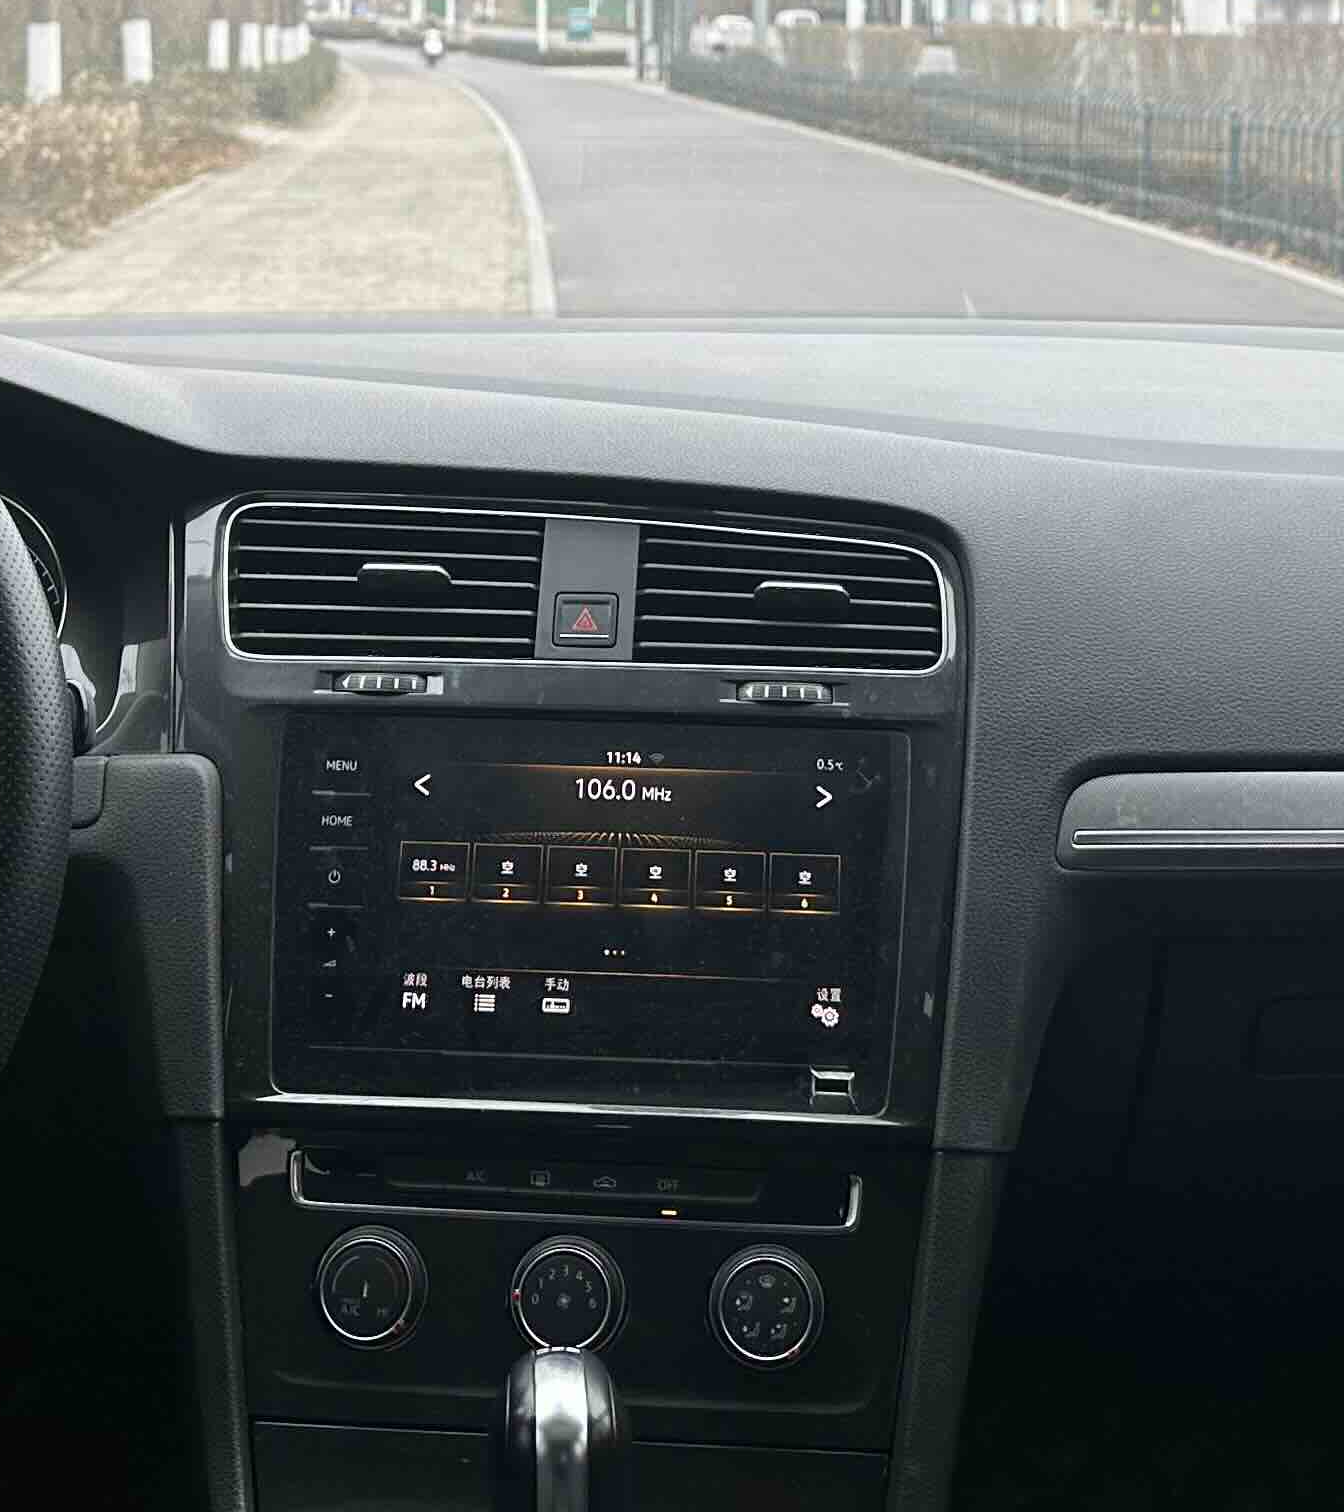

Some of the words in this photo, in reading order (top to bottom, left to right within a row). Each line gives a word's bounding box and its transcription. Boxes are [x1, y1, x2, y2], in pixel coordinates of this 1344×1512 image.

[606, 751, 642, 765] 11:14
[326, 759, 358, 772] MENU
[575, 776, 636, 801] 106.0
[641, 786, 672, 802] MHz
[321, 814, 353, 827] HOME
[411, 858, 438, 872] 88.3
[502, 887, 510, 899] 2
[577, 889, 584, 901] 3
[648, 889, 662, 903] 4
[726, 895, 733, 906] 5
[800, 895, 809, 909] 6
[461, 974, 511, 990] 电台列表
[544, 977, 570, 992] 手动
[401, 991, 427, 1010] FM
